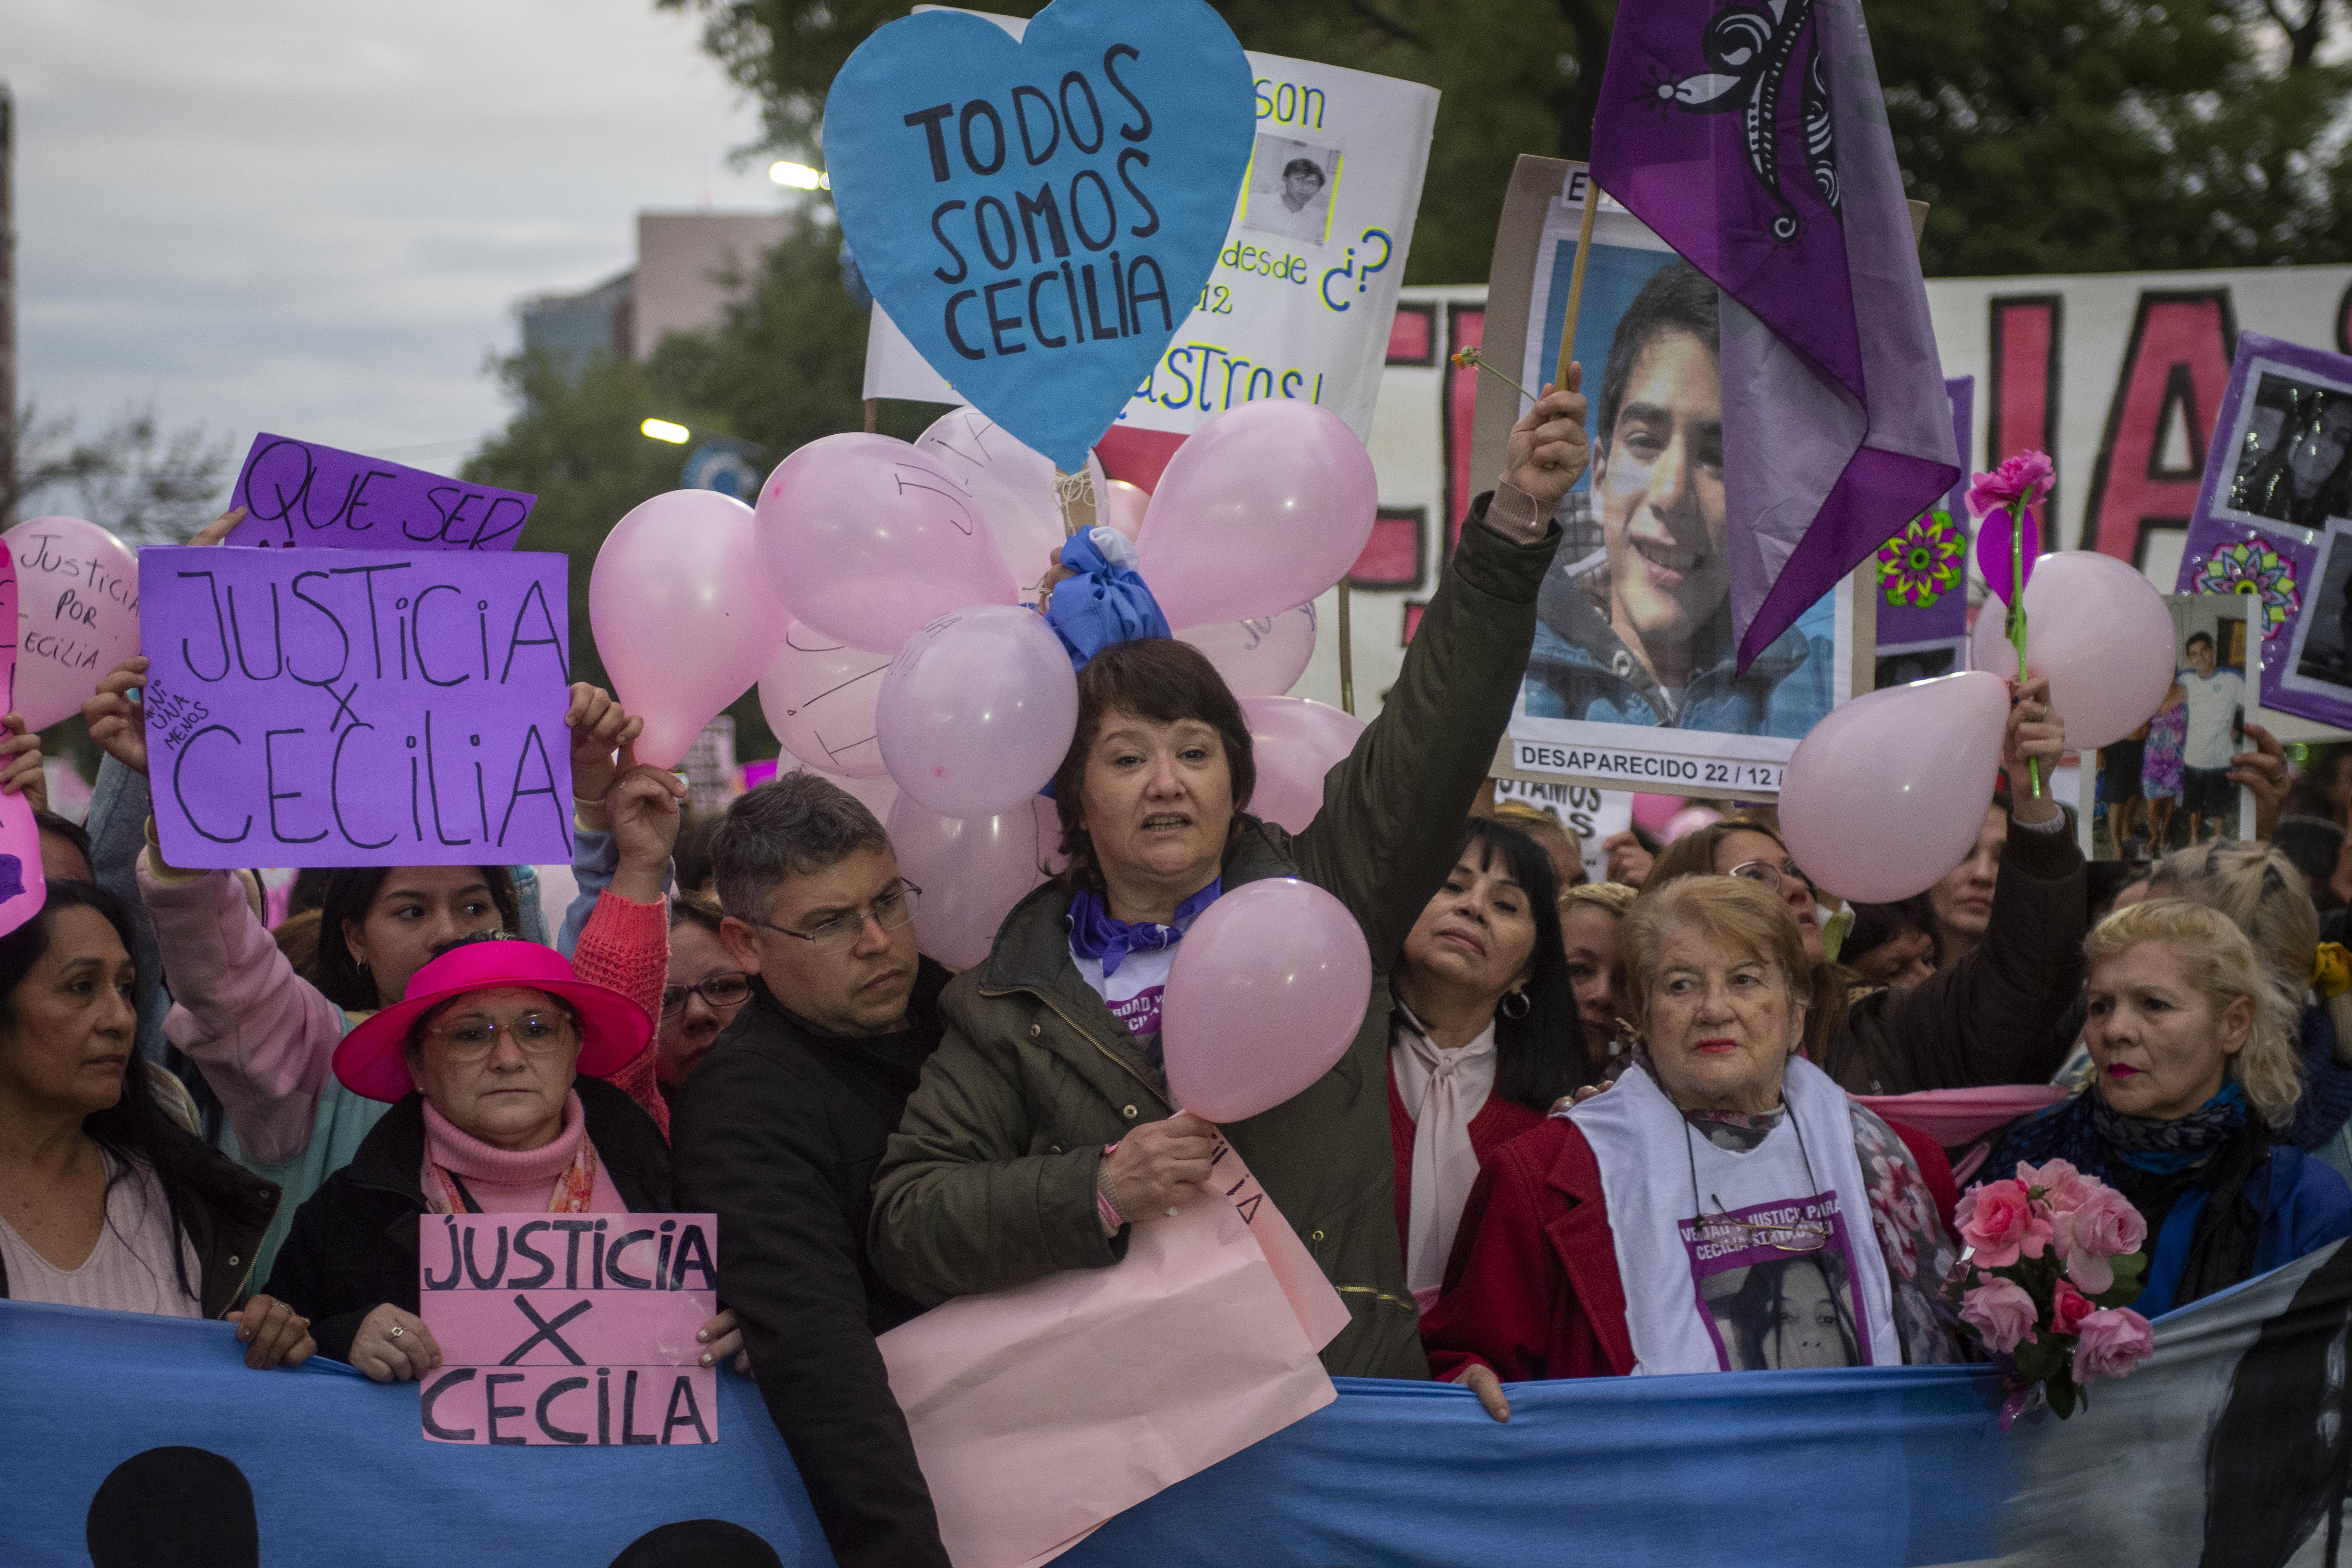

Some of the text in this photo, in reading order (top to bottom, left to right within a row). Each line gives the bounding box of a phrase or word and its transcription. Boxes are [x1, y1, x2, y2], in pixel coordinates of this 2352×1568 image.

[904, 43, 1152, 182] TODOS
[931, 147, 1160, 284] SOMOS
[1219, 240, 1307, 284] desde
[945, 251, 1172, 360] CECILIA
[245, 440, 397, 538] QUE
[55, 589, 96, 628] POR
[18, 613, 99, 669] ECILIA
[151, 695, 190, 729] UNA
[164, 701, 209, 750] MENOS
[1523, 746, 1698, 779] DESAPARECIDO
[1705, 764, 1729, 782] 22
[1748, 767, 1772, 785] 12
[499, 1294, 593, 1366] X
